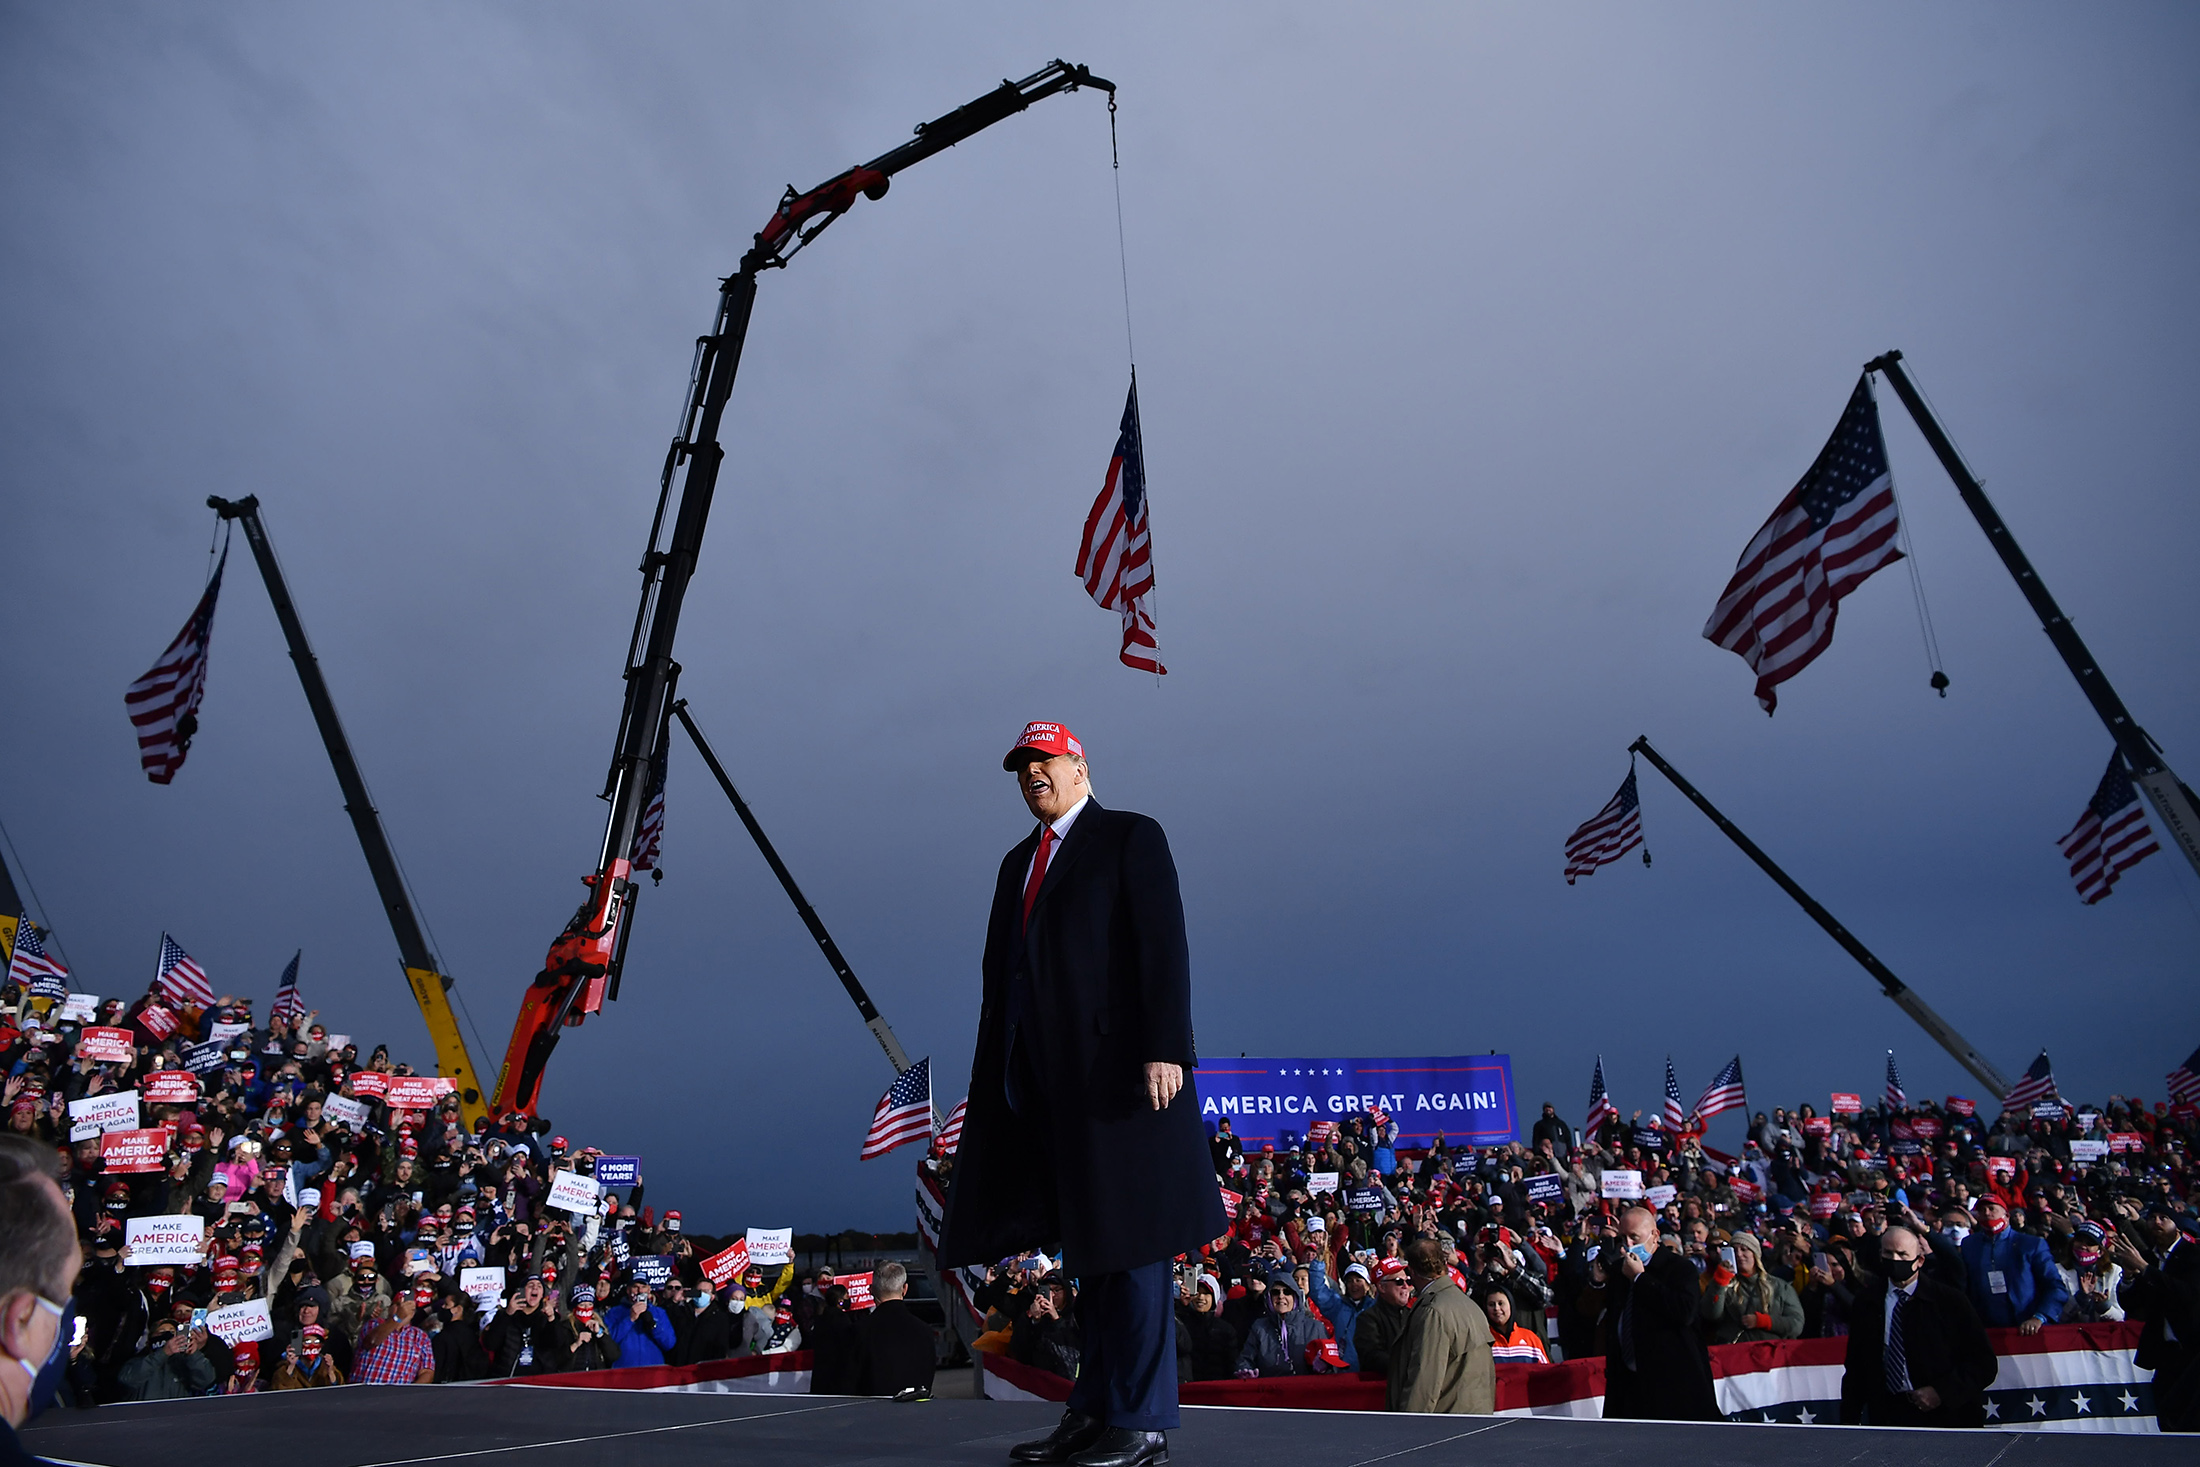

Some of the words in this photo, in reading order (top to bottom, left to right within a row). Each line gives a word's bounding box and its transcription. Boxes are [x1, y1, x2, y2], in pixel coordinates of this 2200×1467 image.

[1026, 724, 1060, 734] AMERICA
[1030, 733, 1055, 742] AGAIN
[2153, 787, 2184, 830] NATIONAL
[98, 1031, 119, 1039] MAKE
[84, 1038, 130, 1048] AMERICA
[872, 1028, 890, 1056] NATIONAL
[192, 1047, 210, 1056] MAKE
[184, 1050, 222, 1068] AMERICA
[353, 1080, 388, 1088] AMERICA
[390, 1088, 433, 1096] AMERICA
[92, 1100, 118, 1111] MAKE
[338, 1102, 356, 1110] MAKE
[1203, 1096, 1318, 1114] AMERICA
[1328, 1094, 1404, 1113] GREAT
[1416, 1091, 1497, 1111] AGAIN!
[76, 1106, 134, 1123] AMERICA
[326, 1105, 364, 1121] AMERICA
[74, 1122, 104, 1133] GREAT
[106, 1117, 136, 1127] AGAIN
[122, 1136, 150, 1145] MAKE
[104, 1144, 163, 1158] AMERICA
[571, 1180, 589, 1189] MAKE
[1528, 1184, 1561, 1195] AMERICA
[552, 1193, 574, 1203] GREAT
[153, 1223, 182, 1231] MAKE
[131, 1233, 200, 1244] AMERICA
[133, 1246, 164, 1255] GREAT
[749, 1242, 789, 1251] AMERICA
[716, 1251, 736, 1266] MAKE
[638, 1260, 660, 1268] MAKE
[708, 1250, 748, 1280] AMERICA
[732, 1257, 749, 1274] AGAIN
[464, 1282, 504, 1293] AMERICA
[848, 1278, 868, 1287] MAKE
[218, 1310, 245, 1320] MAKE
[212, 1315, 266, 1333] MERICA
[239, 1325, 268, 1336] AGAIN
